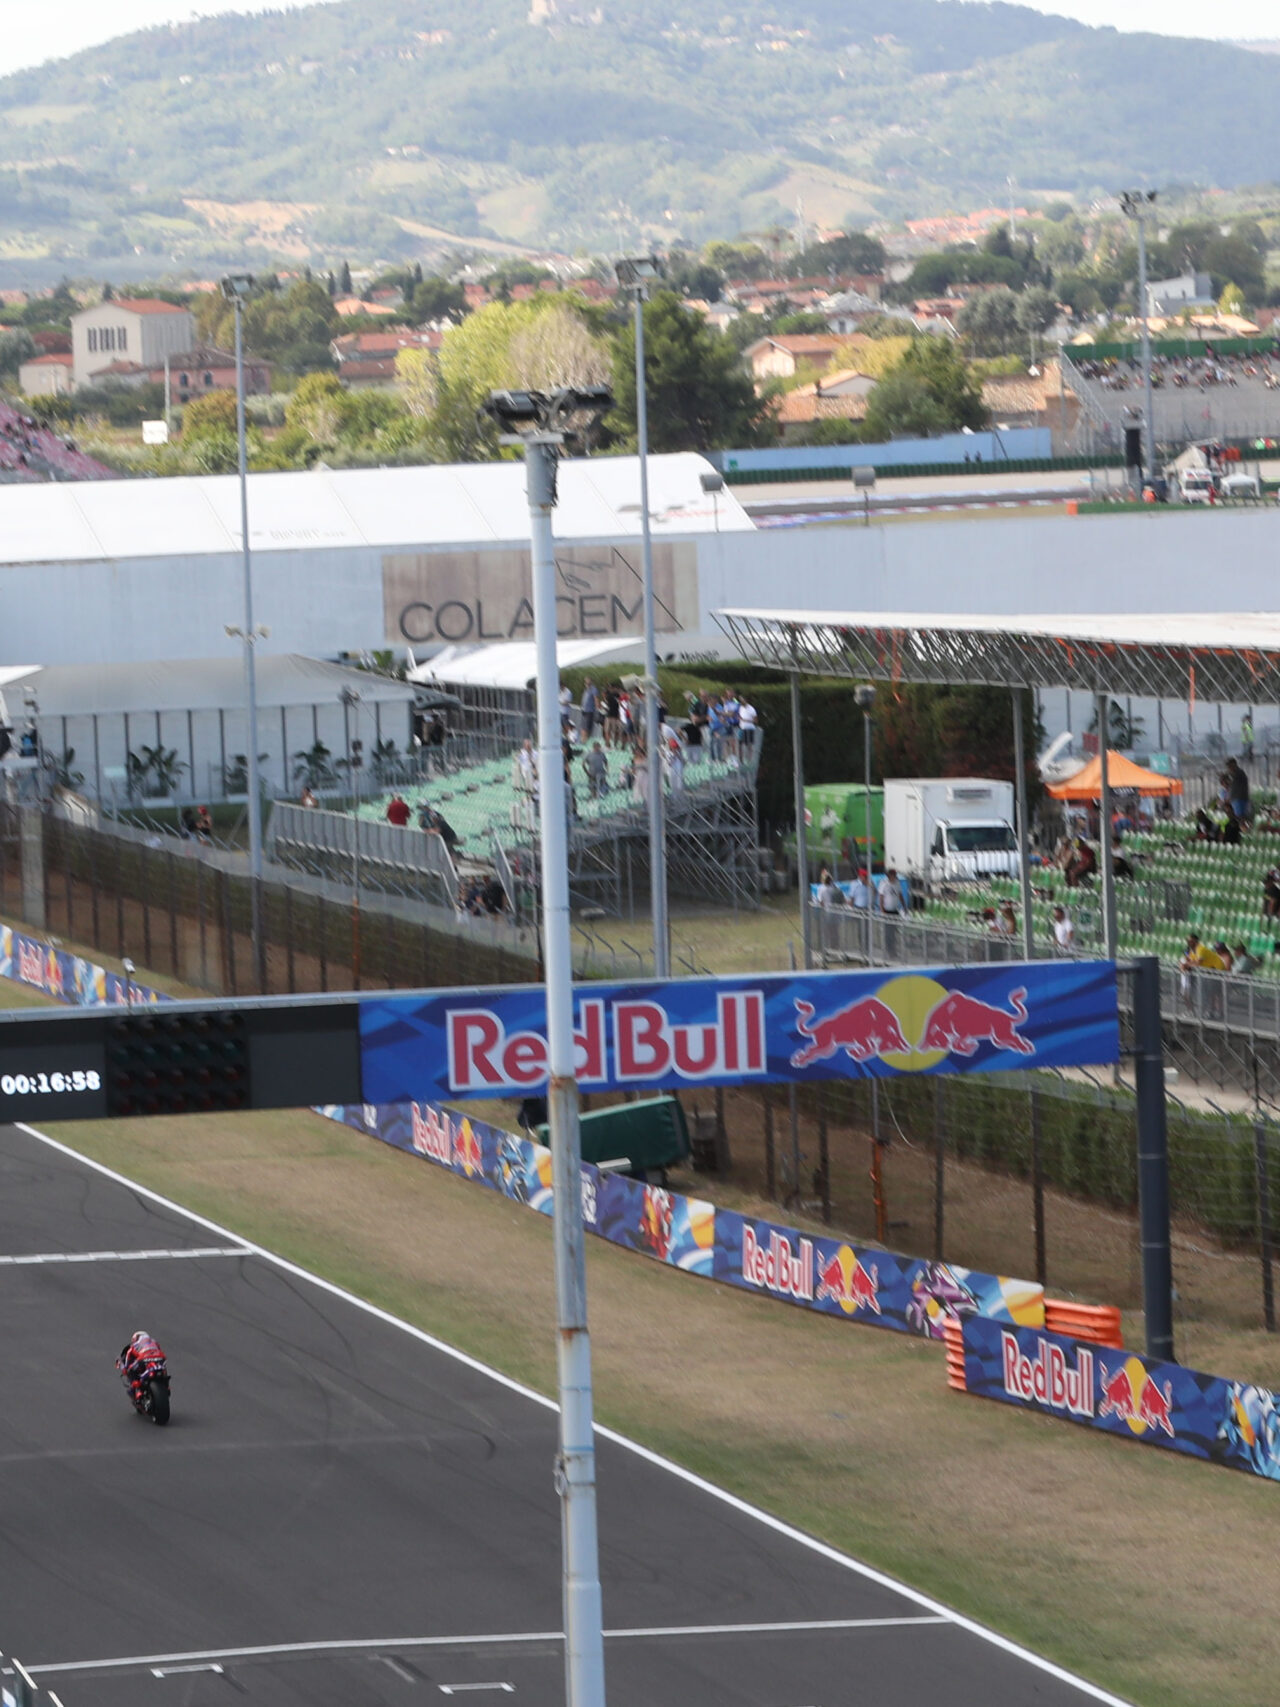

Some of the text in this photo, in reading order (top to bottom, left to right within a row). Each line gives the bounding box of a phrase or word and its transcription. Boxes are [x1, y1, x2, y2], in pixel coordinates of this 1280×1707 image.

[446, 990, 767, 1091] Red Bull
[1, 1070, 101, 1095] 00:16:58
[742, 1223, 814, 1301] Red Bull
[1001, 1330, 1095, 1418] Red Bull
